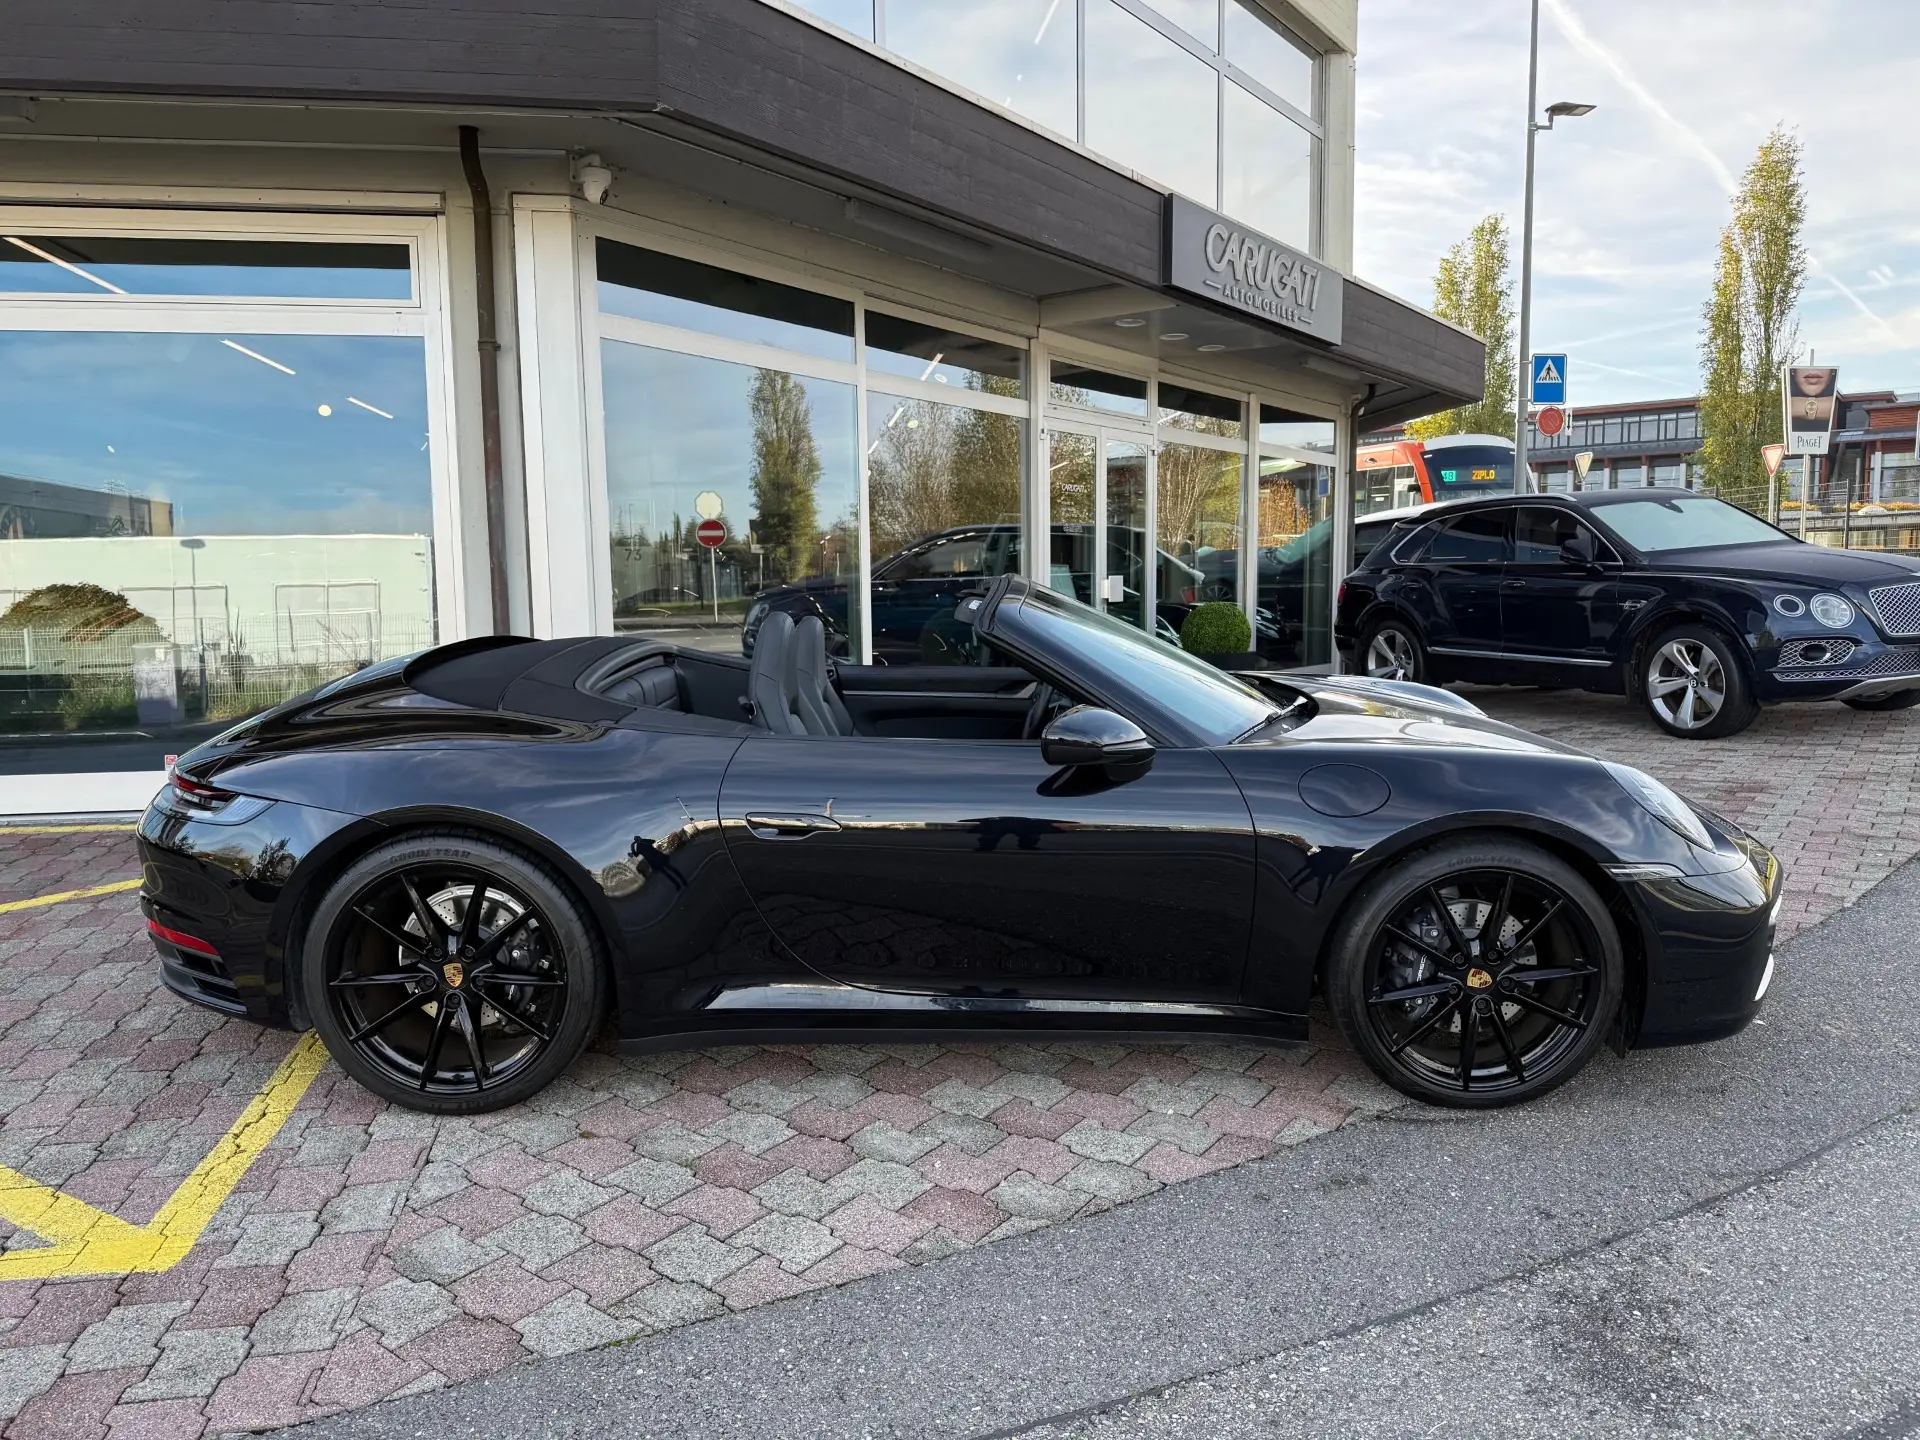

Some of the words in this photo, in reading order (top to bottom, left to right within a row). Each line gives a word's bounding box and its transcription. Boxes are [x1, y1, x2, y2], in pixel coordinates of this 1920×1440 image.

[1205, 223, 1321, 310] CARUGATI
[1223, 283, 1298, 323] AUTOMOBILES
[1797, 435, 1823, 449] PIAGET
